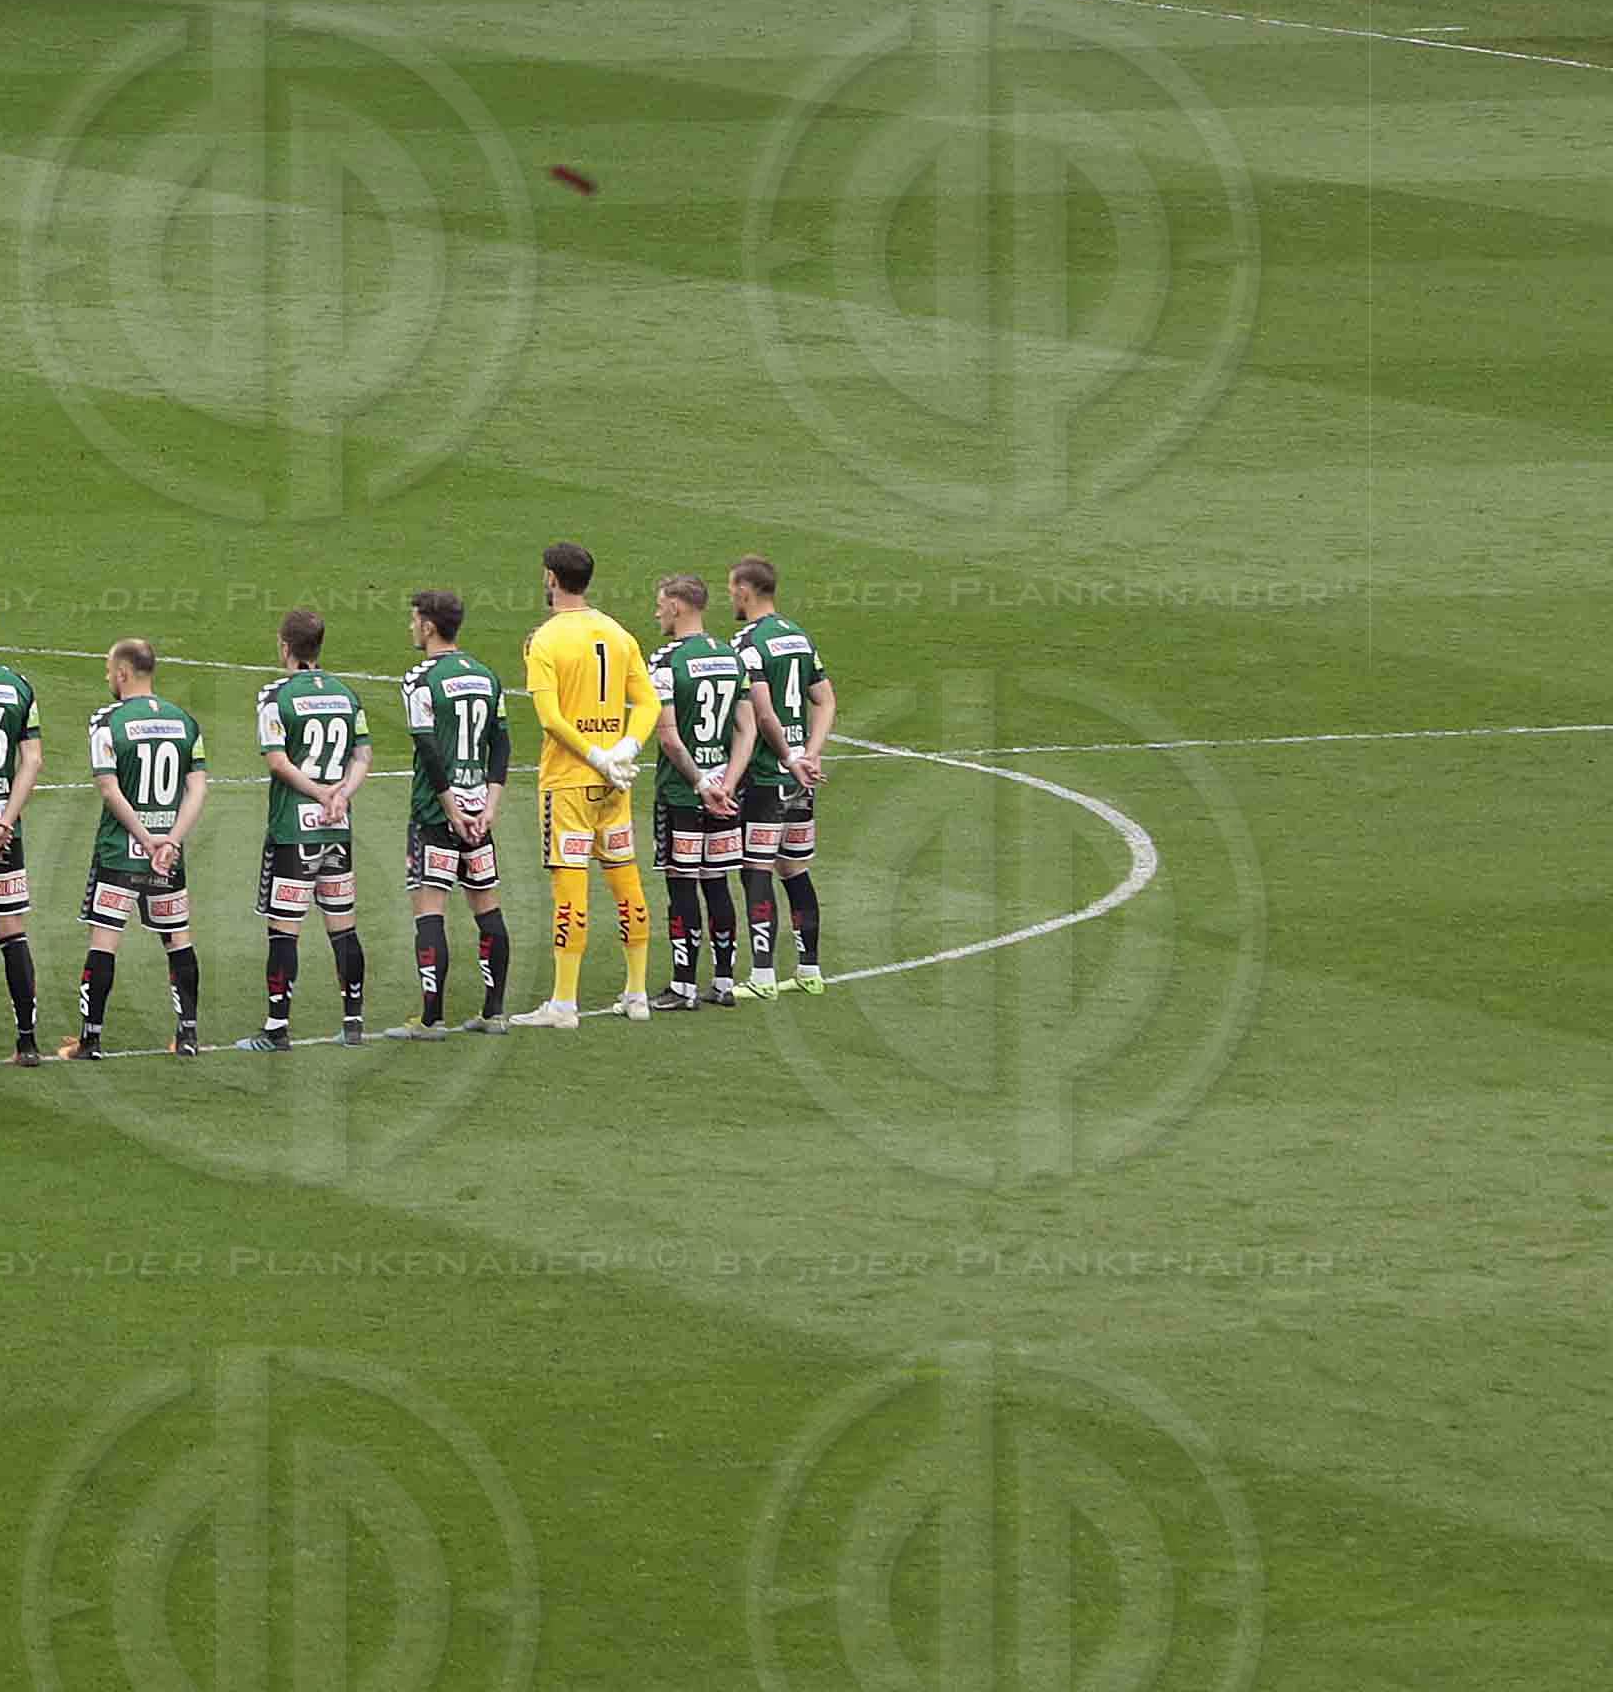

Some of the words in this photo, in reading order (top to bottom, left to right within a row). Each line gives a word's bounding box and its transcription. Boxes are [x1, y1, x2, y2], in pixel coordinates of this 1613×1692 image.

[594, 641, 607, 703] 1
[785, 657, 802, 719] 4
[693, 679, 737, 742] 37
[136, 740, 181, 806] 10
[301, 716, 349, 781] 22
[555, 901, 572, 948] DAXL
